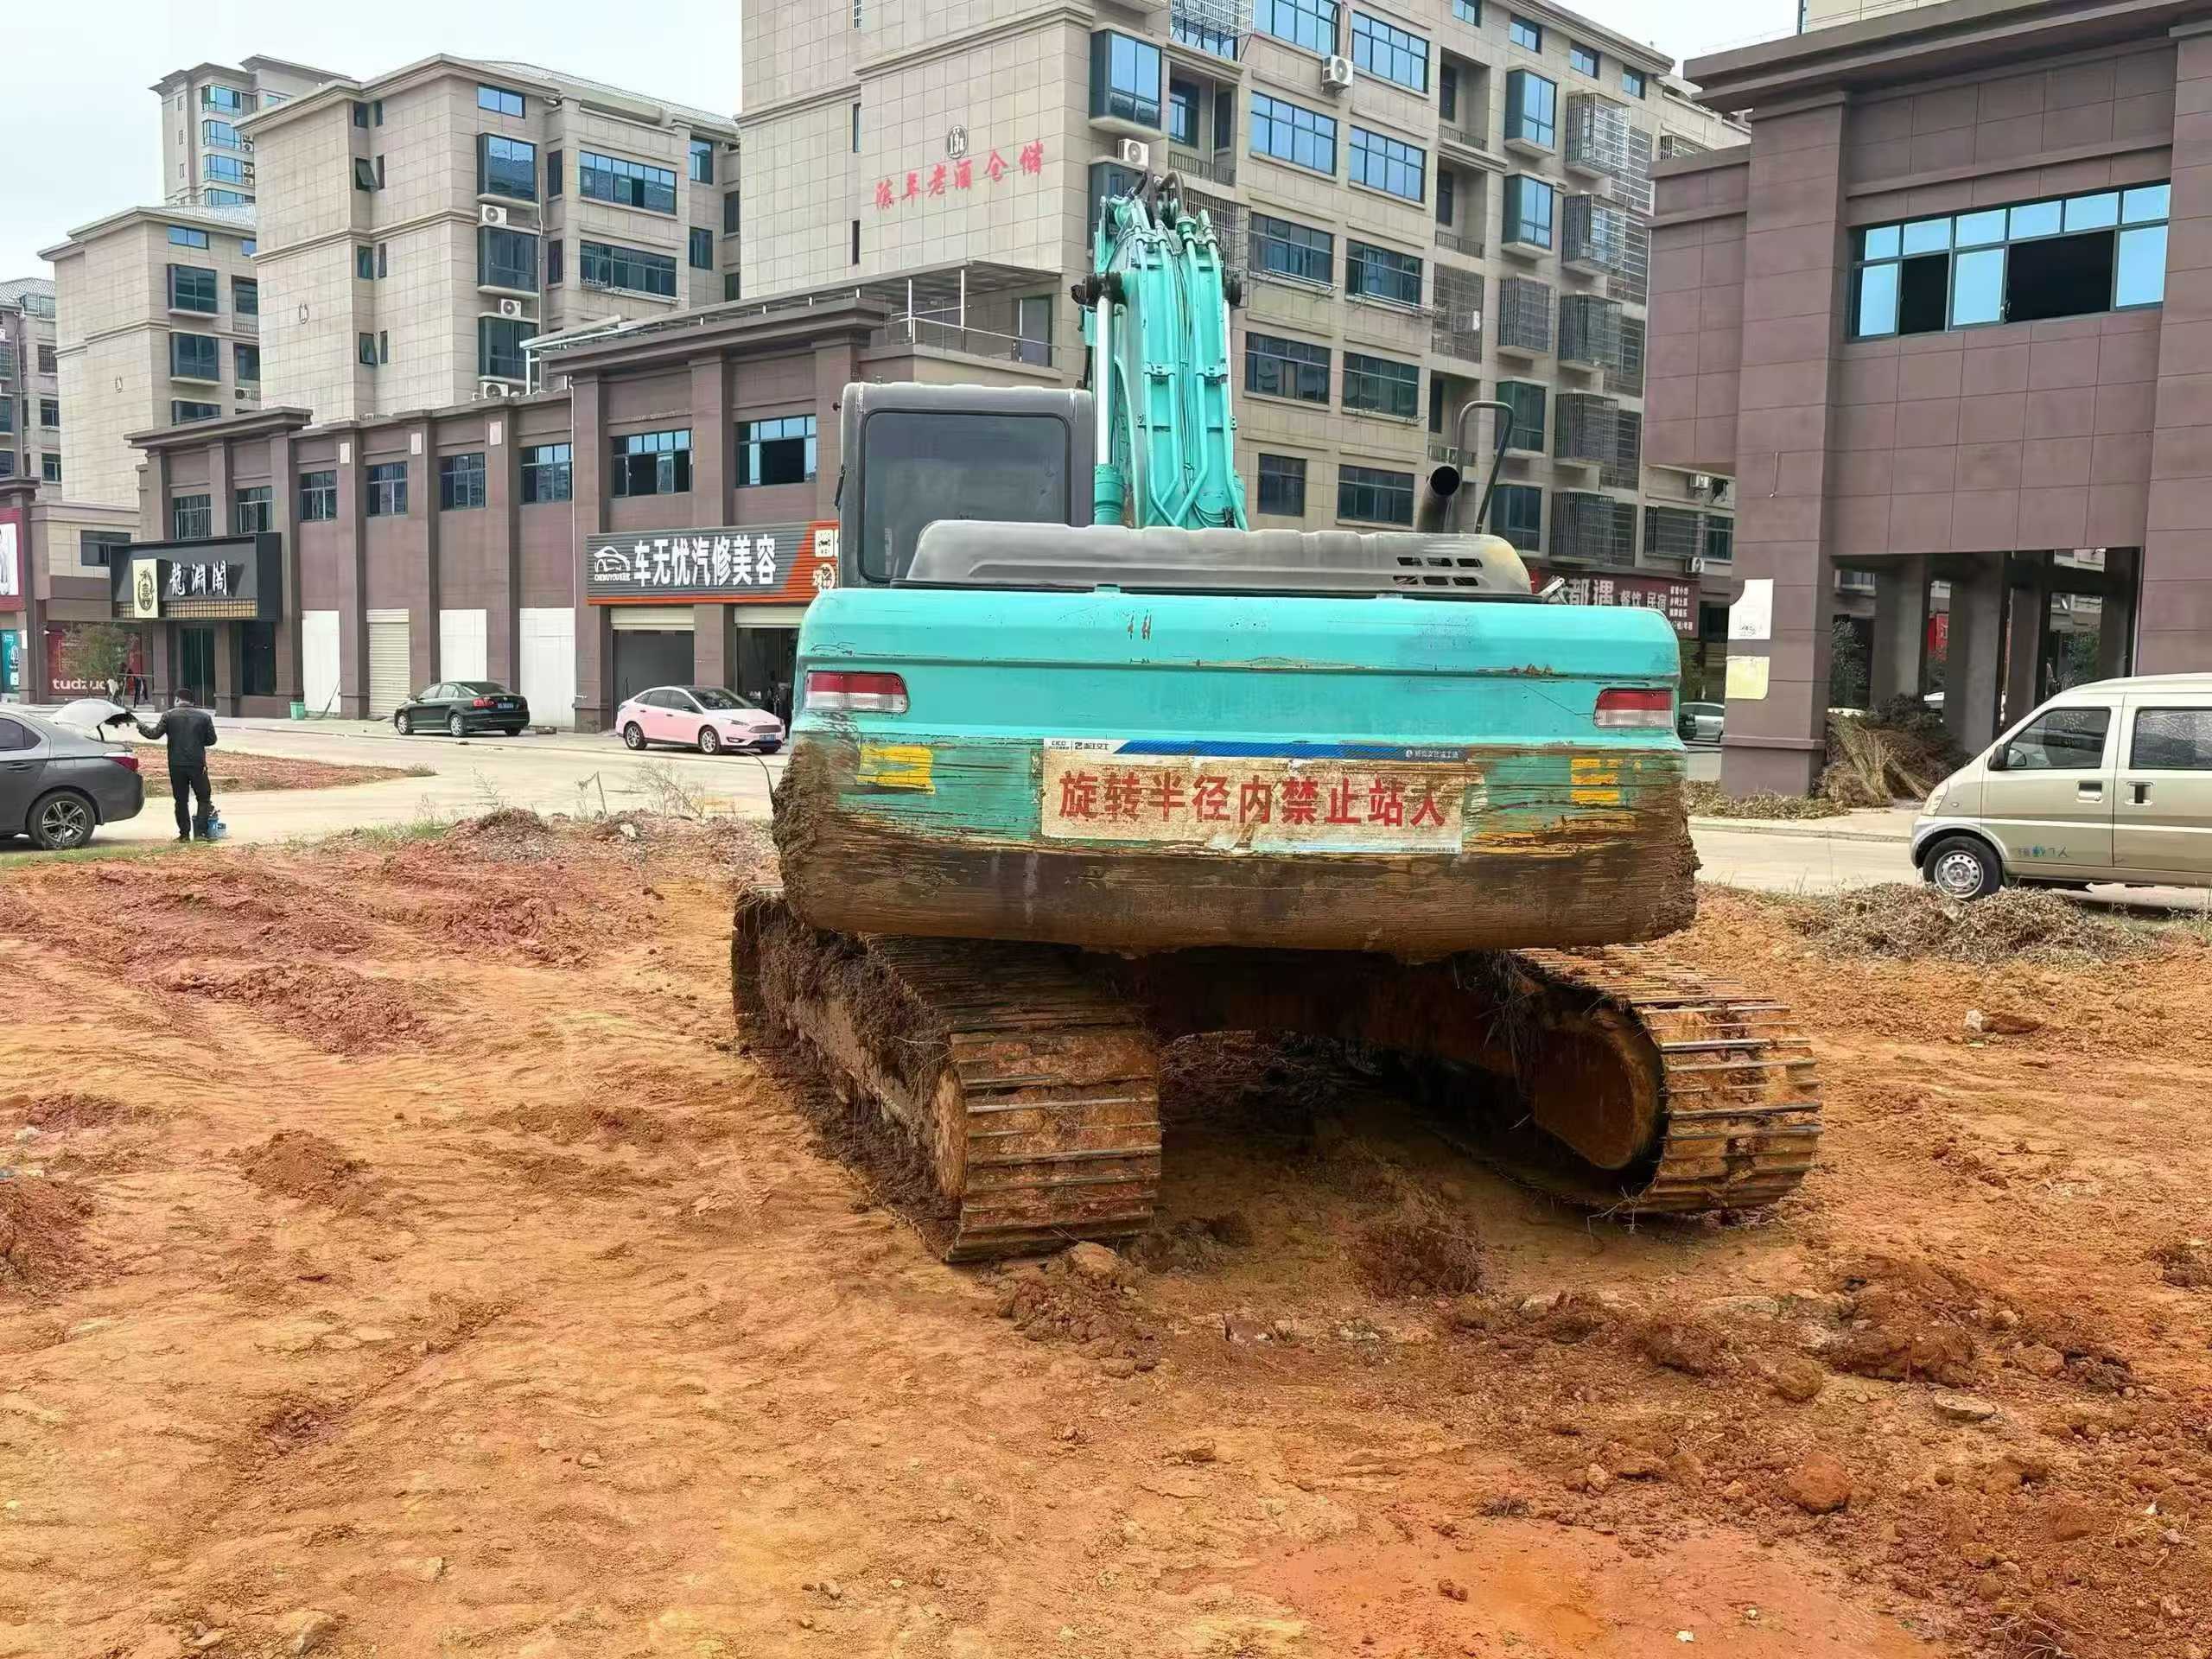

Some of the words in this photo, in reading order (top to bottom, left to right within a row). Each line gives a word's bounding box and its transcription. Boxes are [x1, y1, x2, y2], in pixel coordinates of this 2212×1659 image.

[633, 534, 777, 588] 车无忧汽修美容
[1058, 769, 1446, 827] 旋转半径内禁止站人
